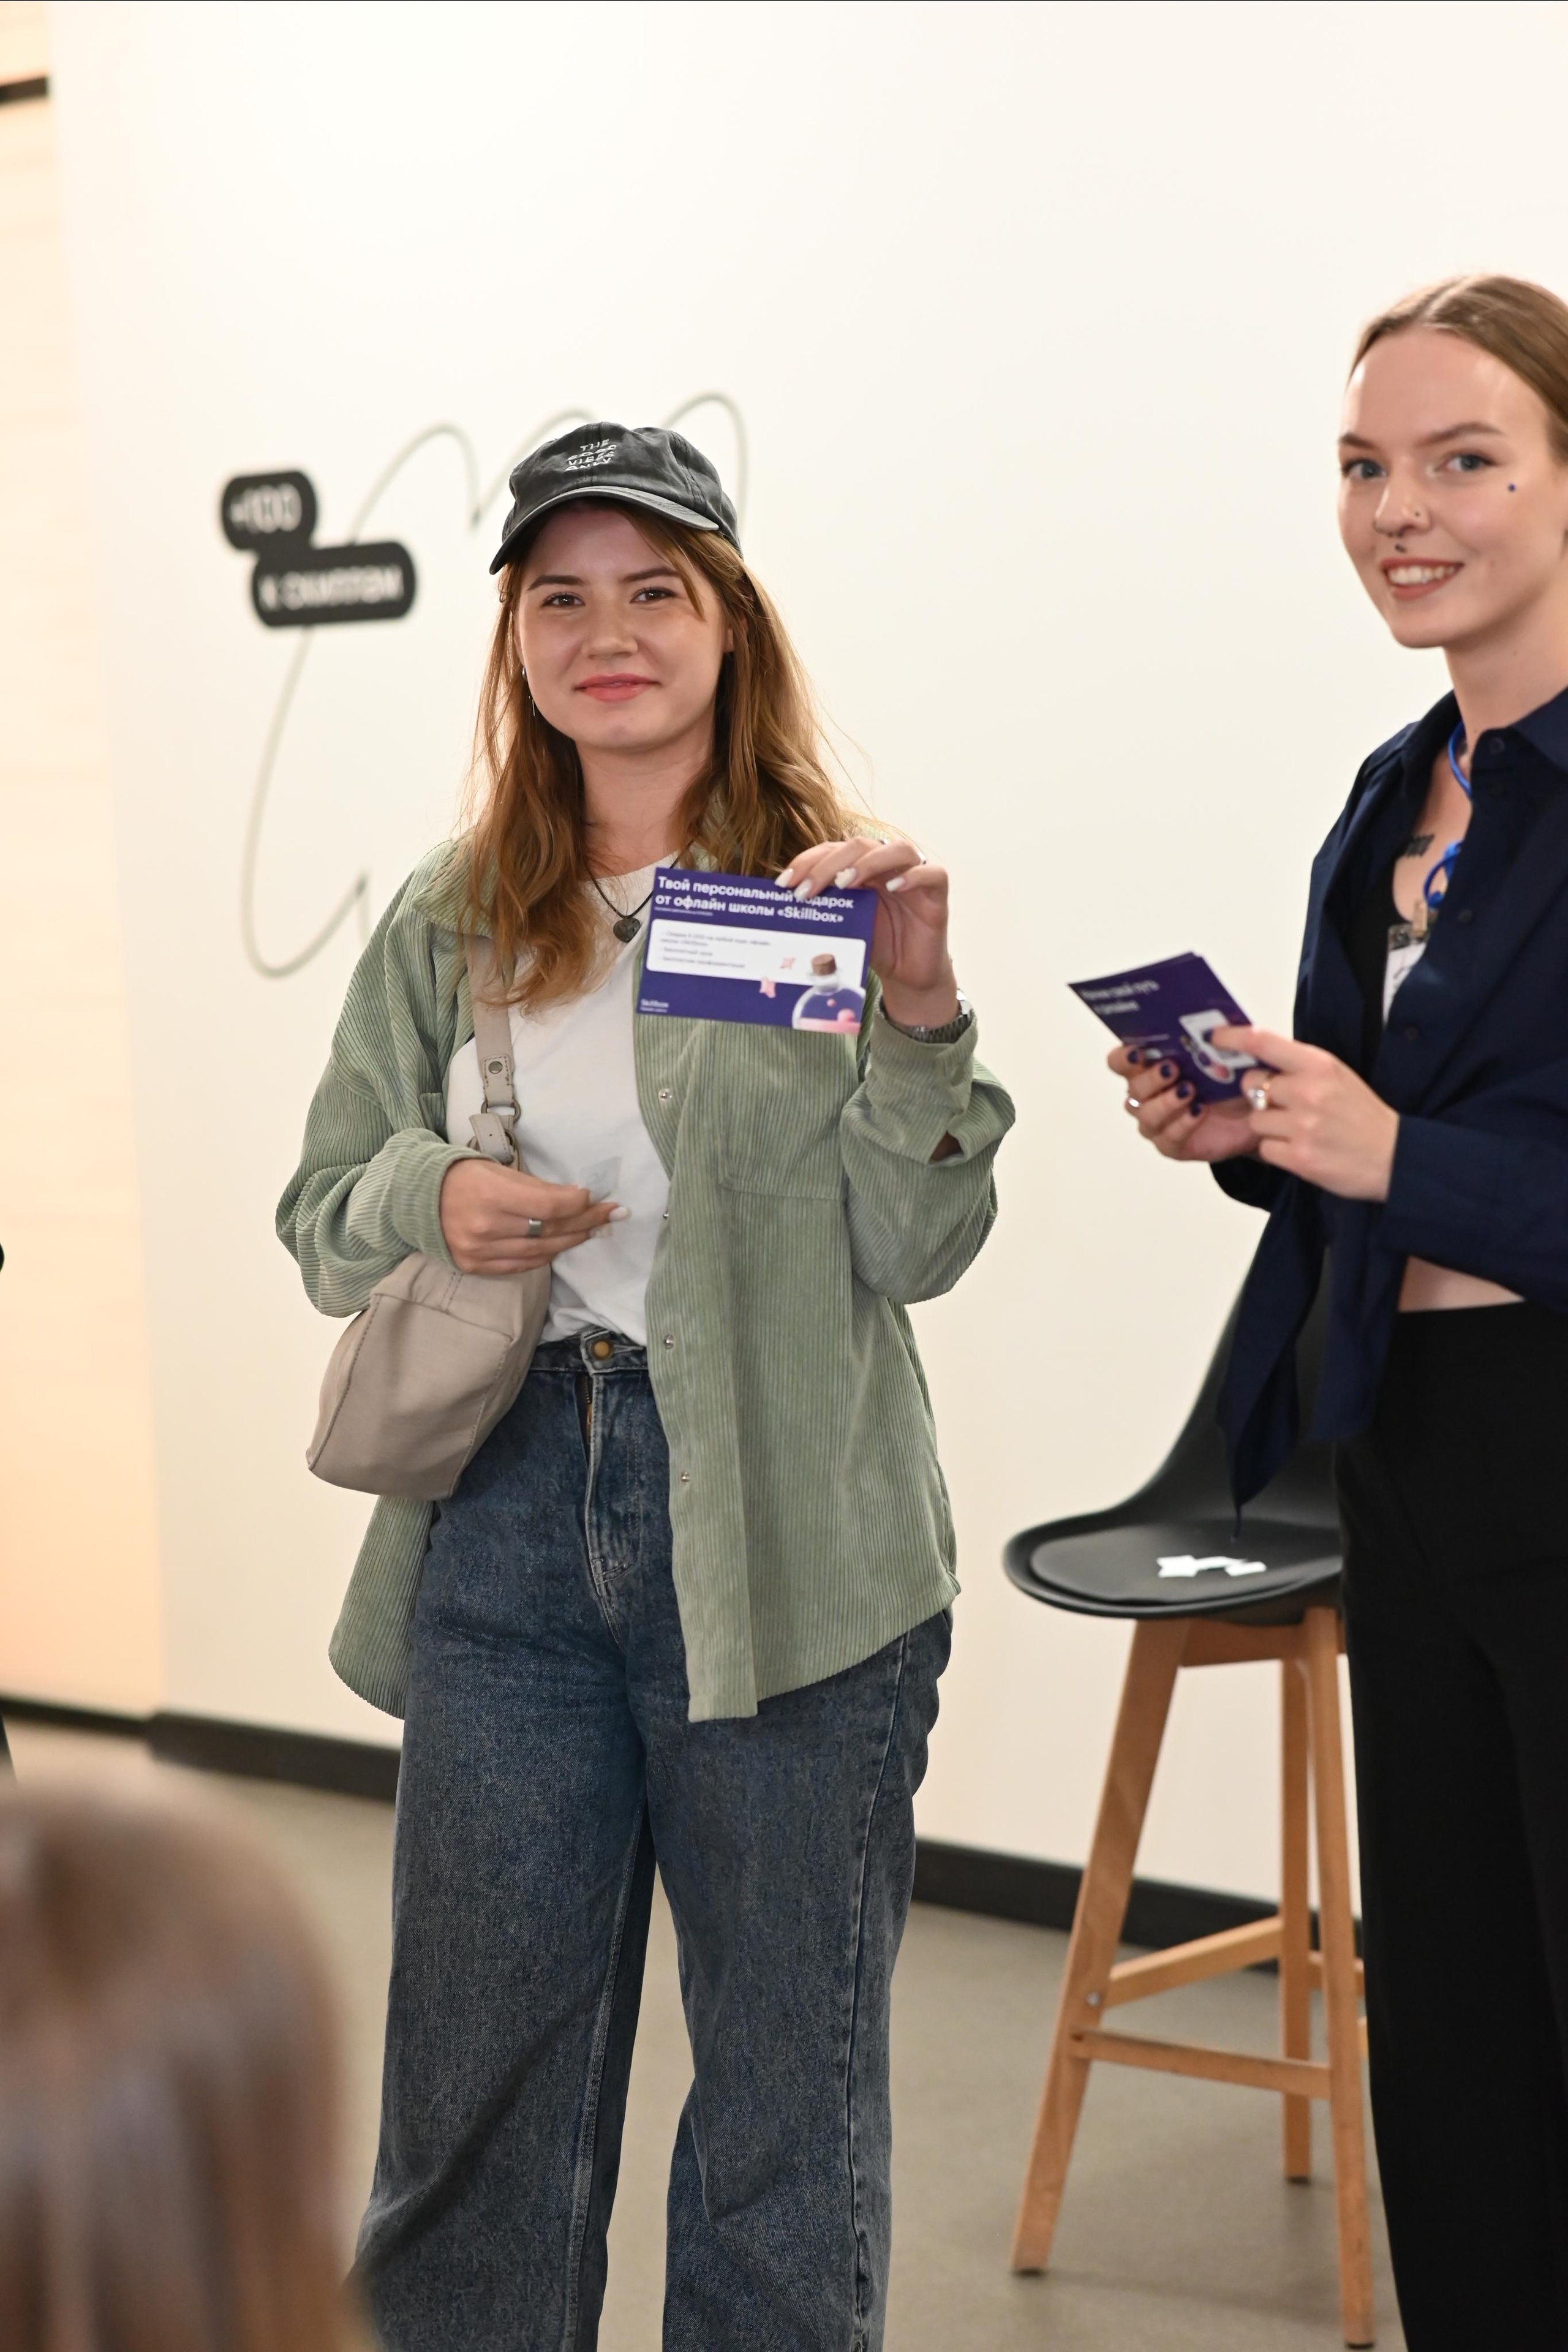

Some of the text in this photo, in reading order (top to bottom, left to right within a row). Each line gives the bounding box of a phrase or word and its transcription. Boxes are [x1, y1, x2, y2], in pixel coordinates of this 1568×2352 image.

[579, 439, 609, 451] THE
[568, 451, 614, 466] VIBES
[658, 876, 690, 891] Твой
[693, 882, 793, 902] персональный
[655, 895, 672, 905] от
[674, 895, 726, 911] офлайн
[728, 902, 775, 916] школы
[777, 906, 844, 922] «Skillbox»
